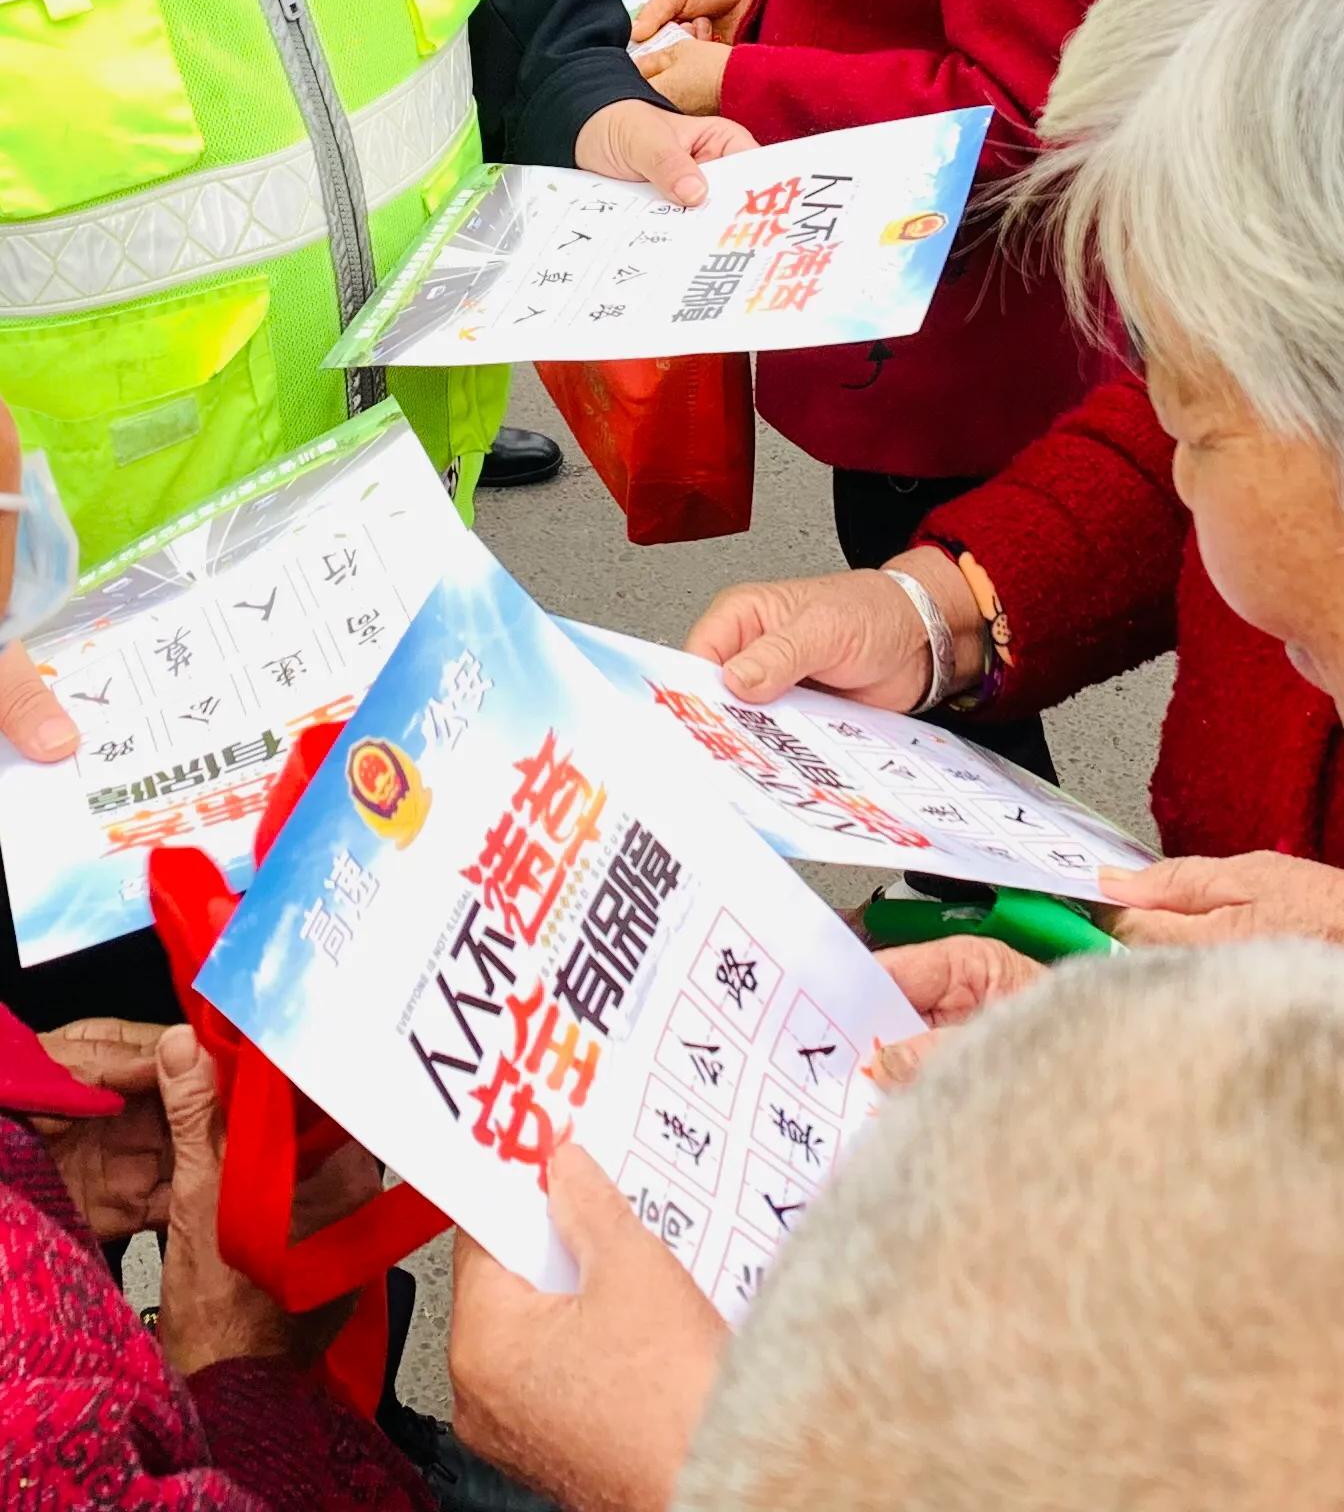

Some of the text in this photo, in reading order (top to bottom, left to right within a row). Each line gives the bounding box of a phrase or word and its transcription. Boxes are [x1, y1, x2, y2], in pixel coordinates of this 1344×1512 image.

[670, 175, 804, 325] 安全有保障
[745, 173, 854, 316] 人人不违章
[297, 648, 496, 967] 高速 公安
[408, 727, 608, 1121] 人人不违章
[396, 972, 430, 1036] EVERYONE
[426, 958, 437, 973] IS
[432, 932, 449, 959] NOT
[467, 819, 682, 1194] 安全有保障
